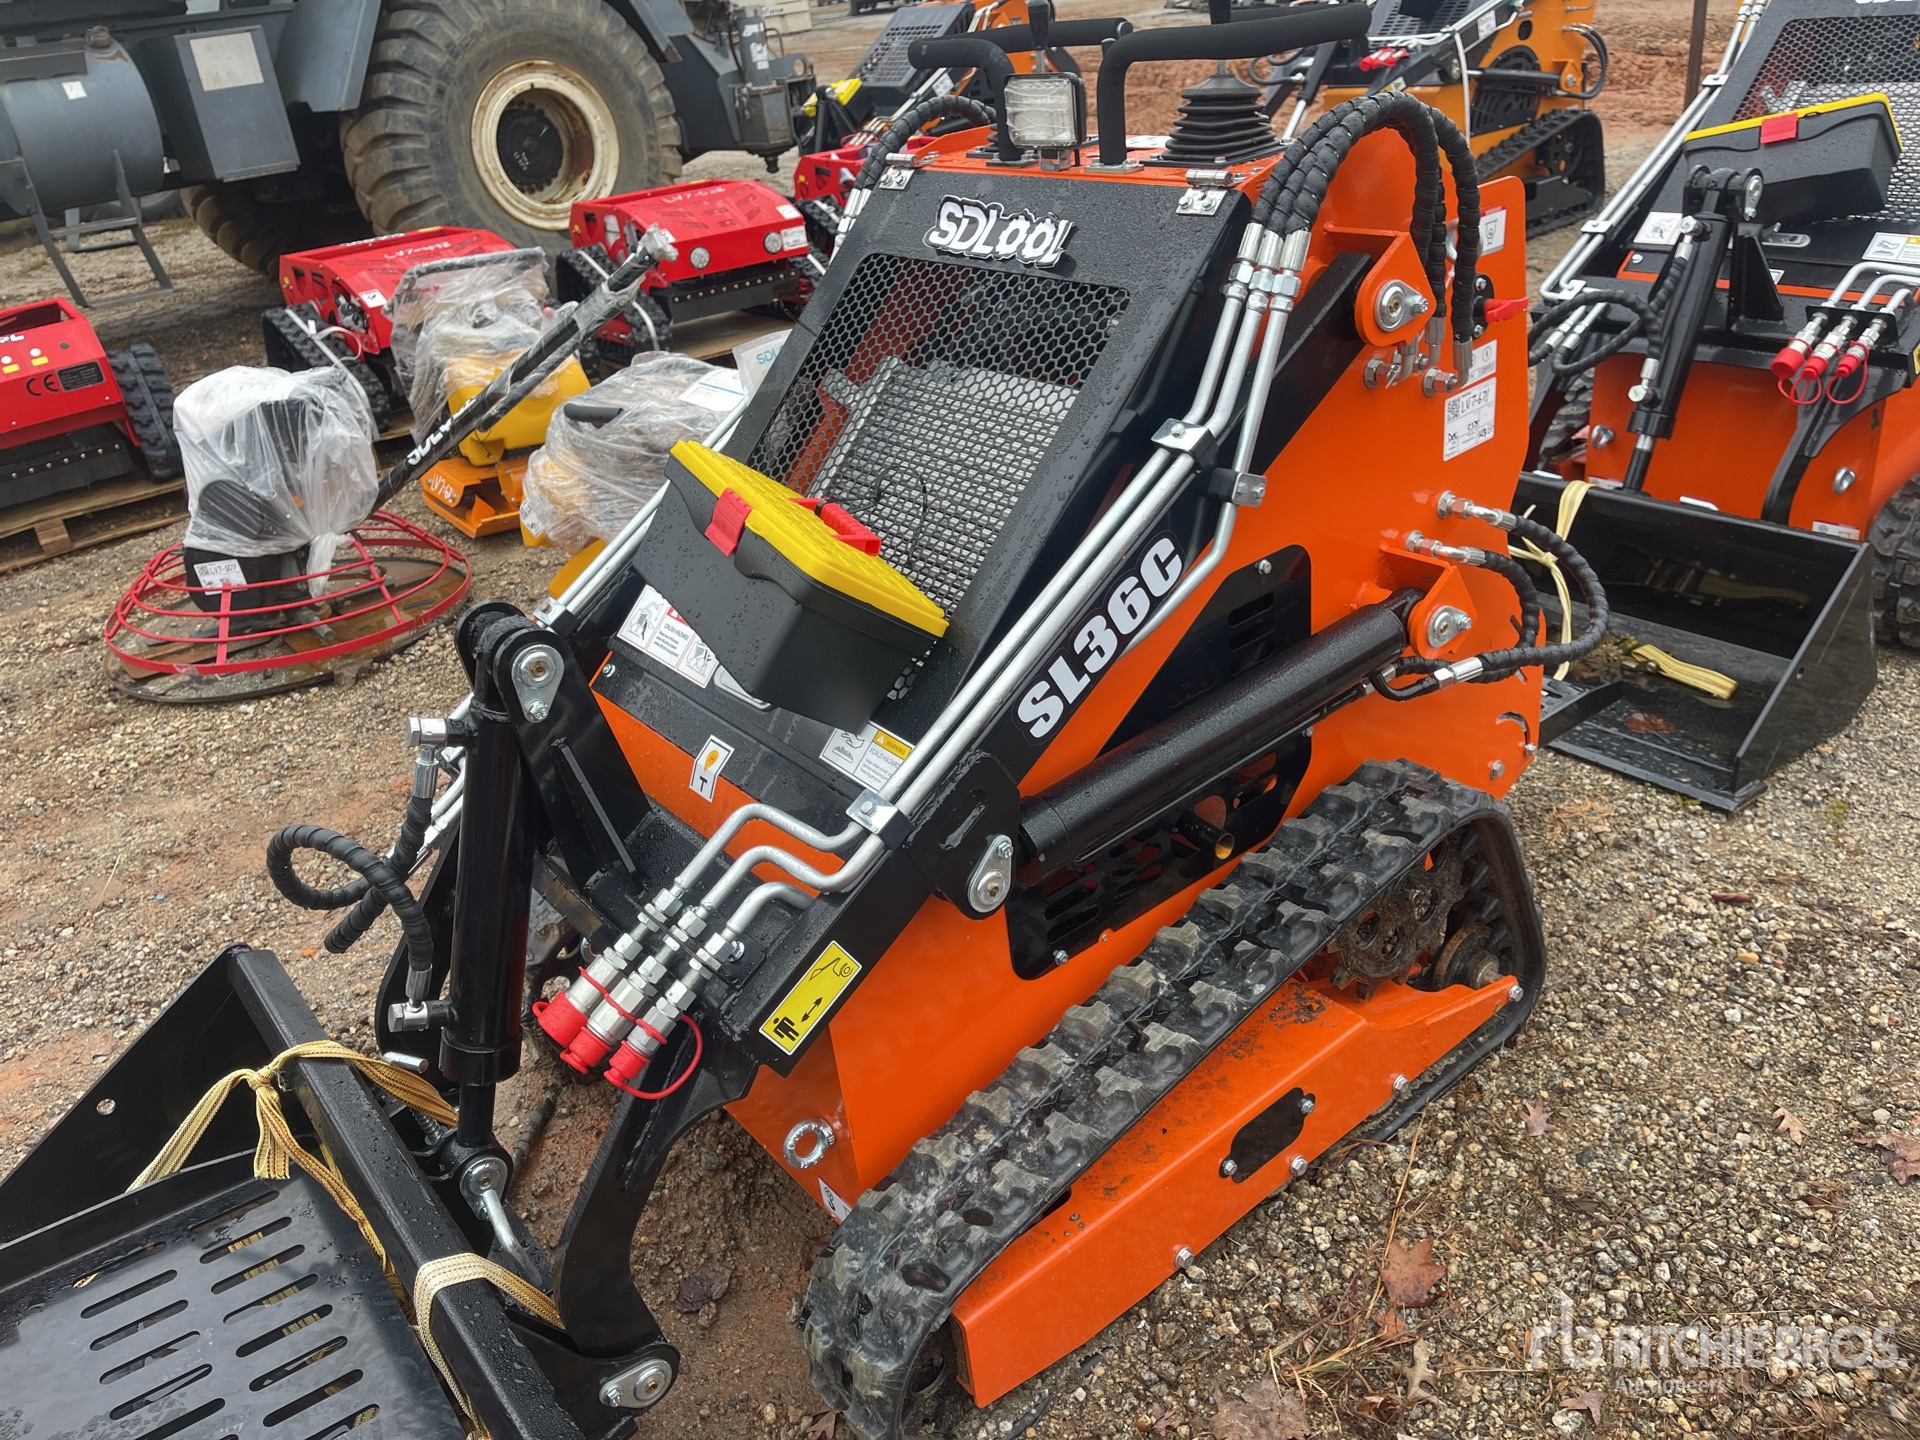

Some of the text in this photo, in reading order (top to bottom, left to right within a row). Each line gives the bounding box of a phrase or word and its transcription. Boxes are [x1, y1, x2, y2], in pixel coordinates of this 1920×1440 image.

[926, 199, 1072, 265] SDLOOL
[1017, 537, 1183, 738] SL36C
[869, 747, 884, 759] SCALD
[886, 741, 905, 755] WARNING
